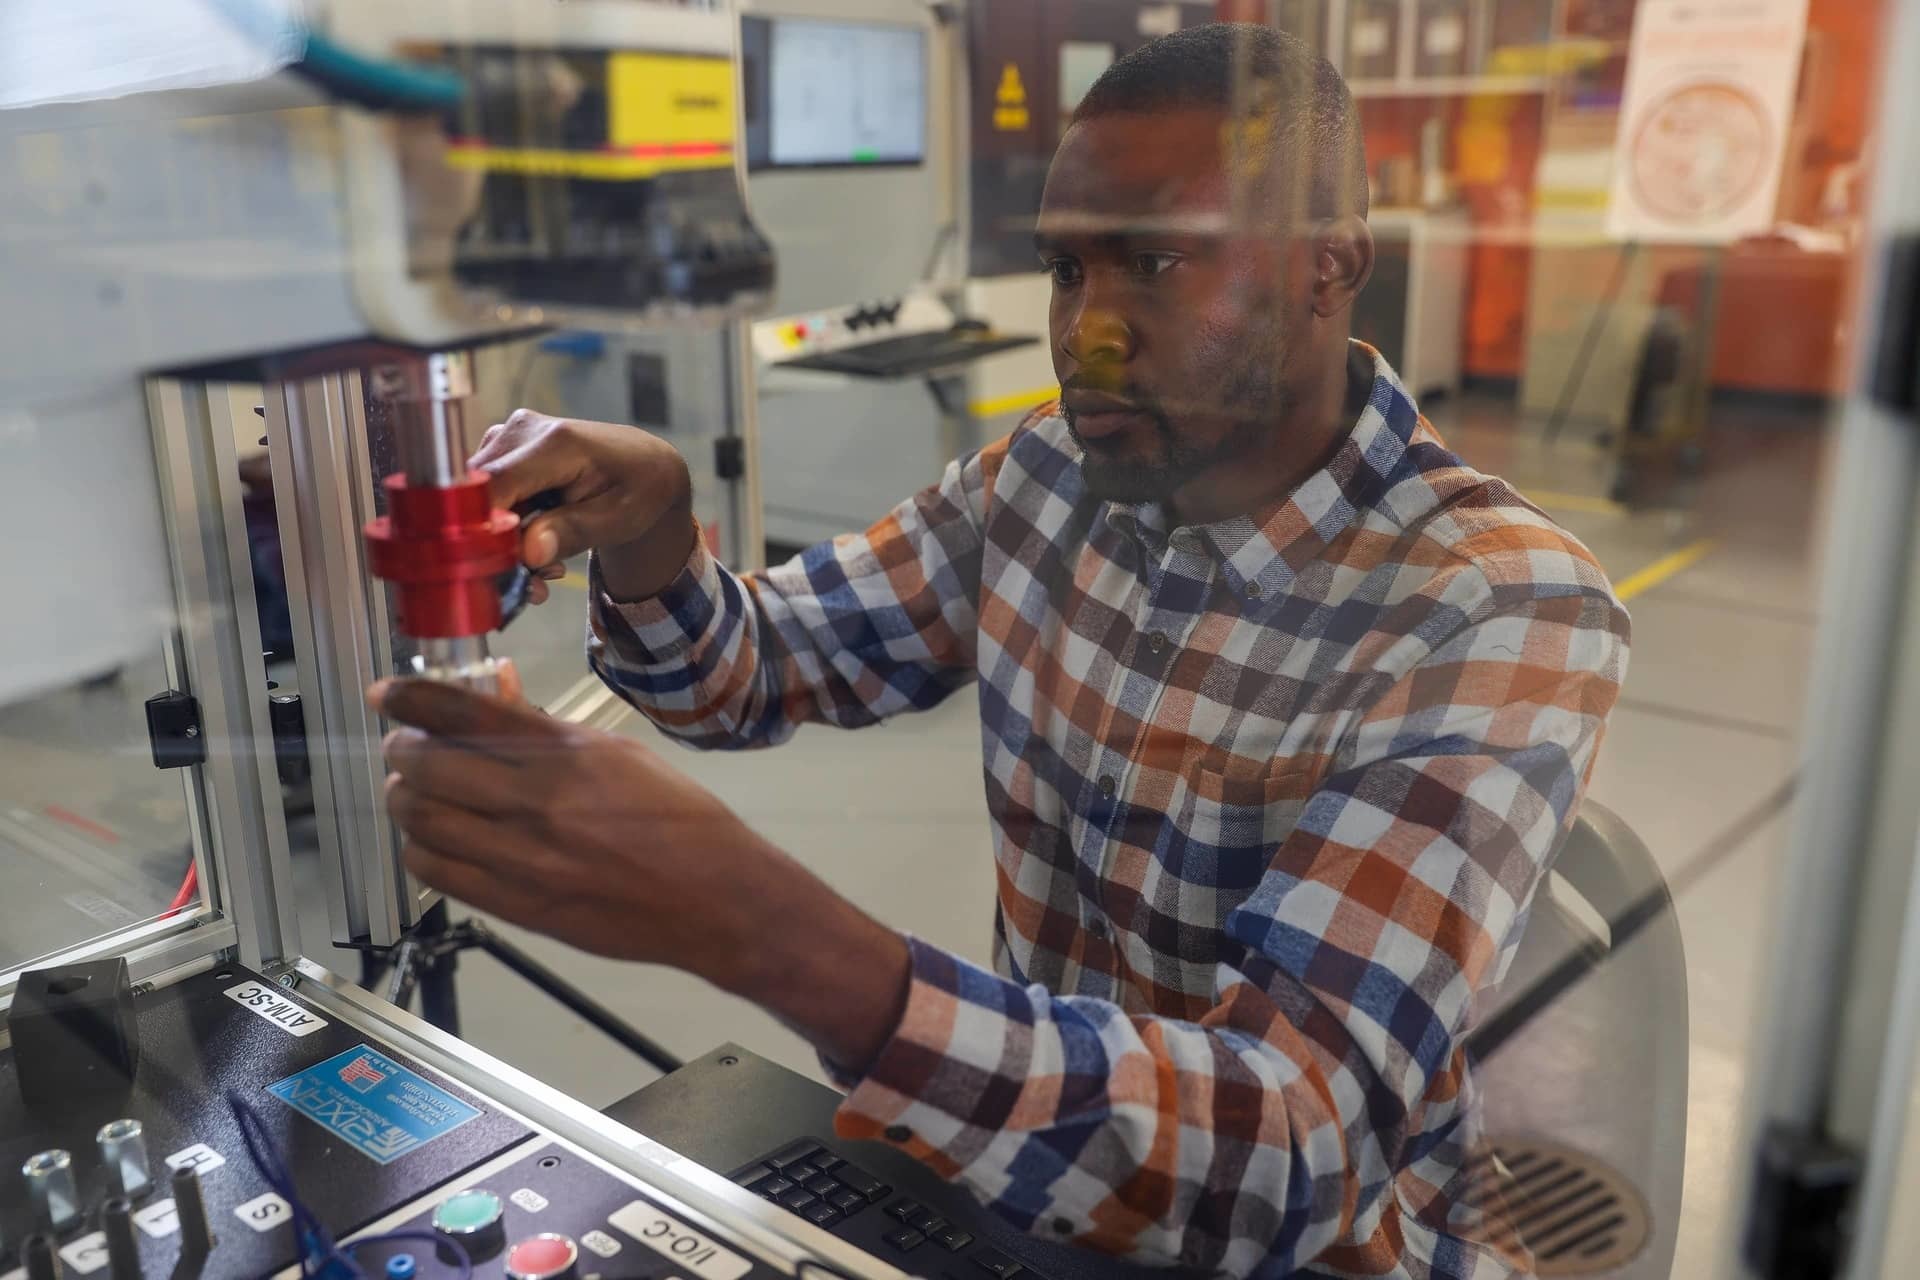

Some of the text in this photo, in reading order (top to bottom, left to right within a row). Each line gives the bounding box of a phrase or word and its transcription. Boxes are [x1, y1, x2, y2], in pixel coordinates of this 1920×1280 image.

[237, 987, 314, 1028] ATM-SC
[179, 1151, 213, 1169] H
[251, 1202, 280, 1221] S
[643, 1219, 717, 1266] I/O-C
